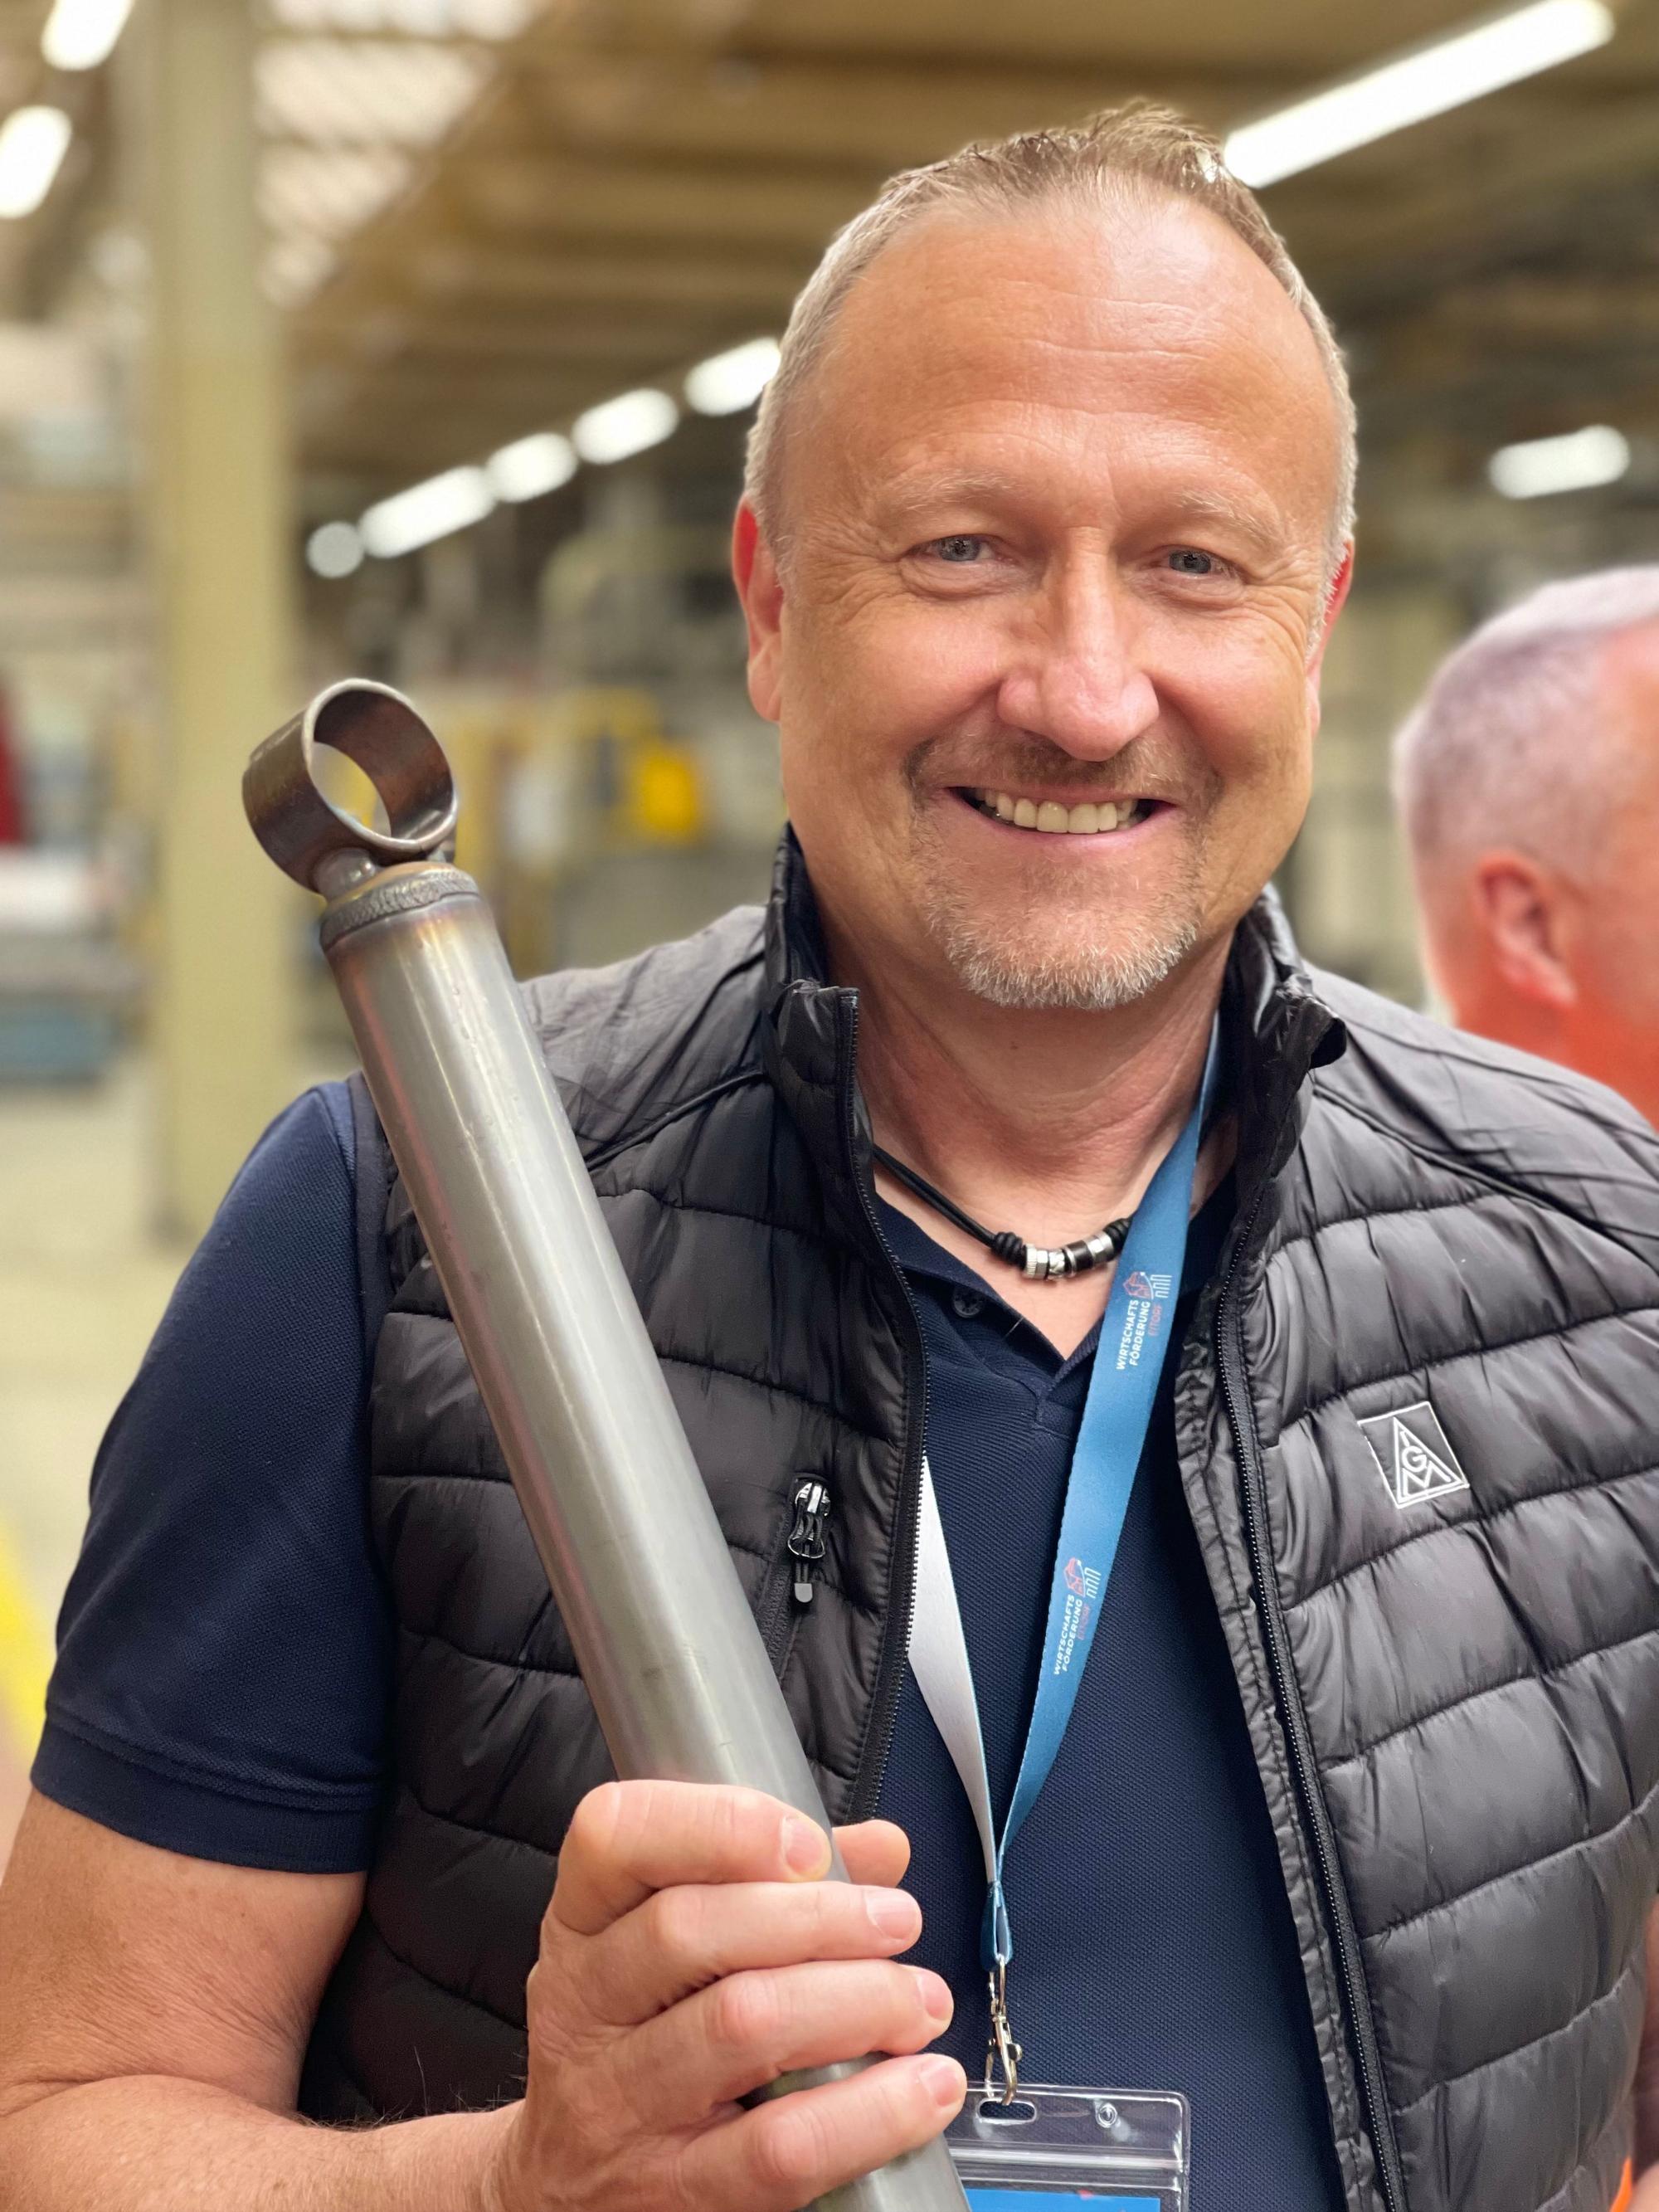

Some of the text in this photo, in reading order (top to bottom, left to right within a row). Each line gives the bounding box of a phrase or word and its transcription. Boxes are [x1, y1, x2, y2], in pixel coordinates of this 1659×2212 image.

[1116, 1299, 1140, 1370] WIRTSCHAFTS
[1129, 1301, 1151, 1367] FÖRDERUNG
[1053, 1595, 1075, 1675] WIRTSCHAFTS
